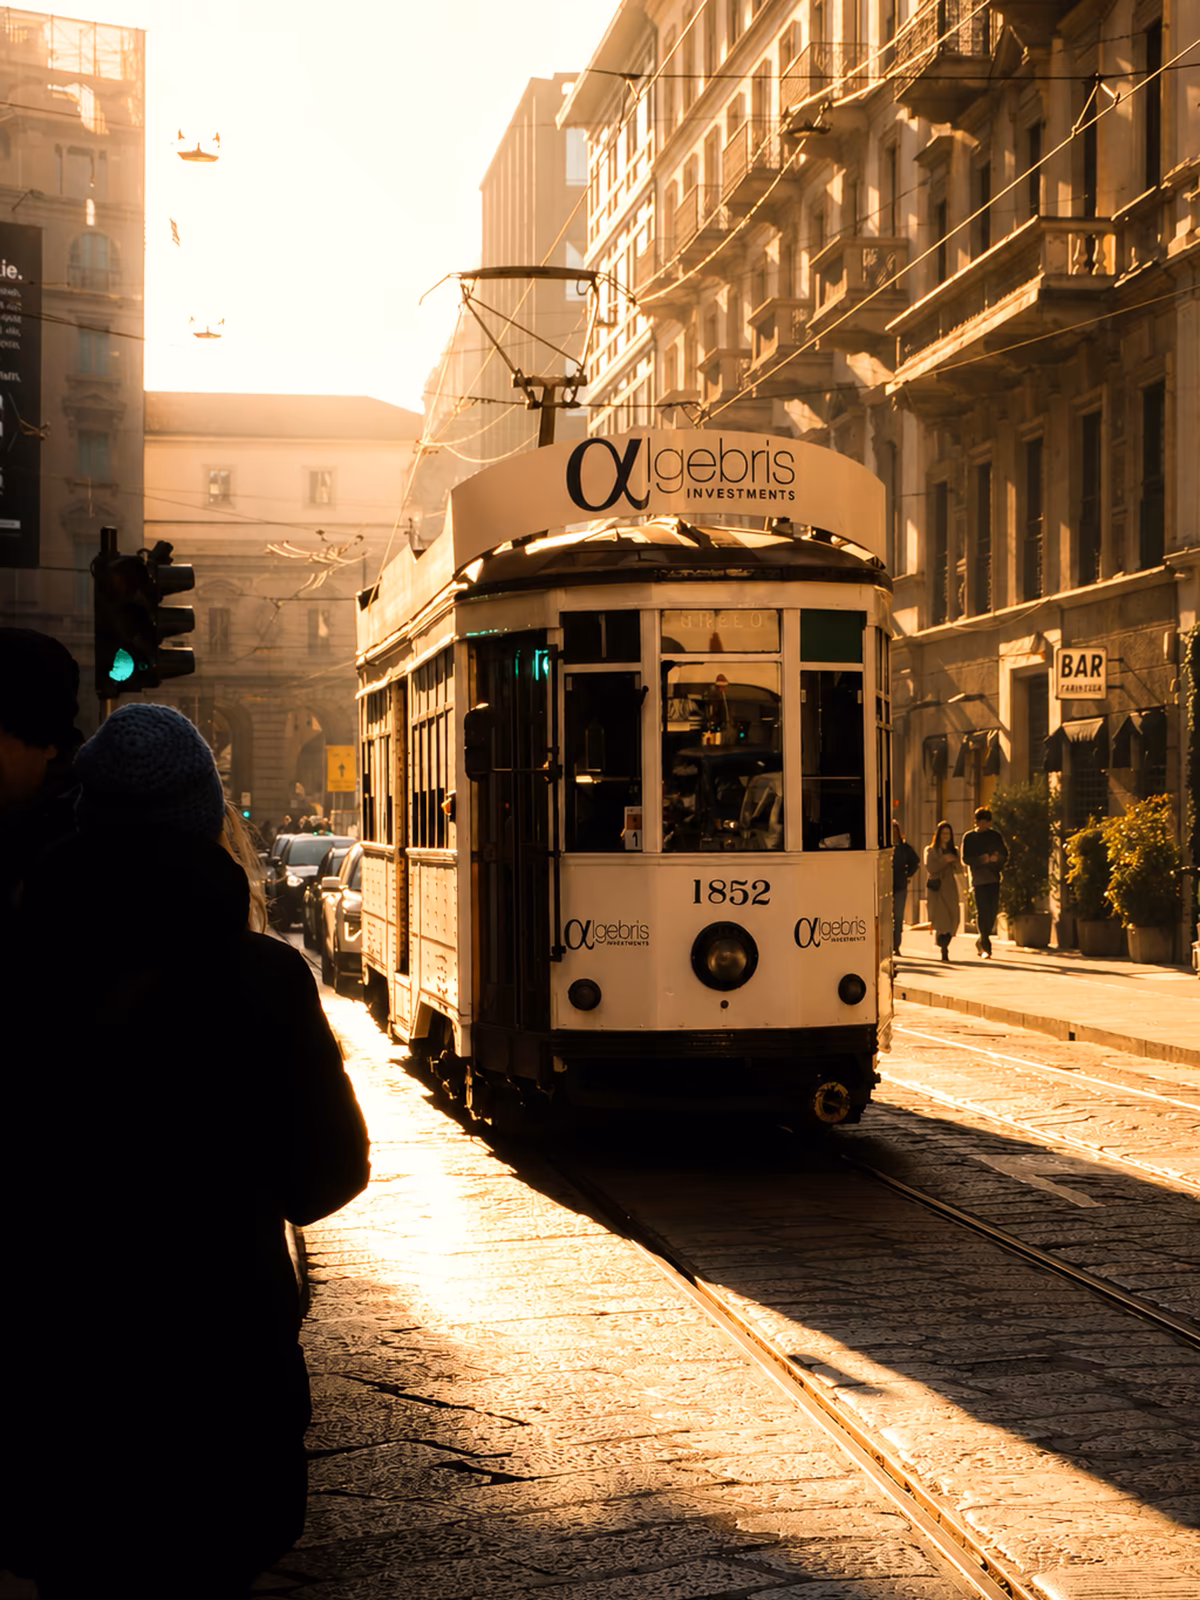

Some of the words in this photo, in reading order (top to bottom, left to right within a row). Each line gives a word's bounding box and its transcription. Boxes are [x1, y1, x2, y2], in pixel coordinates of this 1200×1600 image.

[0, 259, 23, 280] ie.
[687, 488, 796, 501] INVESTMENTS
[1060, 653, 1103, 679] BAR
[632, 831, 639, 848] 1
[693, 879, 771, 906] 1852
